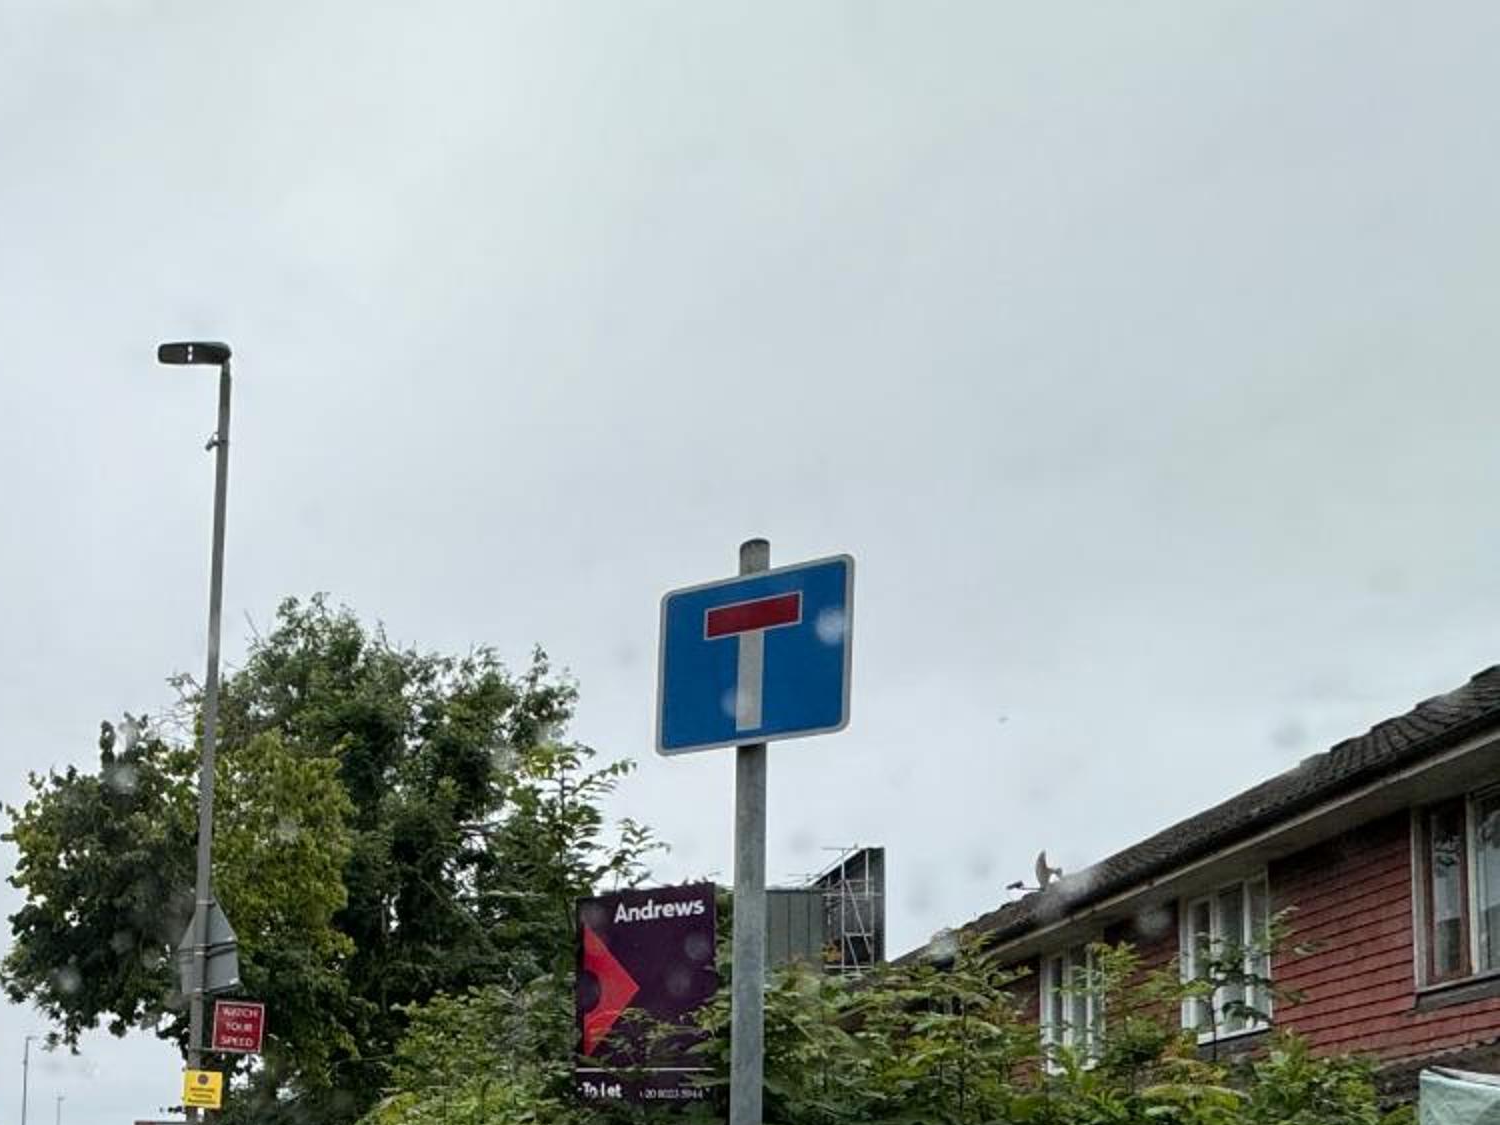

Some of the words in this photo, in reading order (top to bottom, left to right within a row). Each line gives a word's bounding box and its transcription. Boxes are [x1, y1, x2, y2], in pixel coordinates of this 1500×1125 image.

[614, 899, 705, 924] Andrews
[222, 1007, 259, 1019] WATCH
[225, 1022, 253, 1033] YOUR
[220, 1035, 254, 1048] SPEED
[582, 1081, 598, 1098] To
